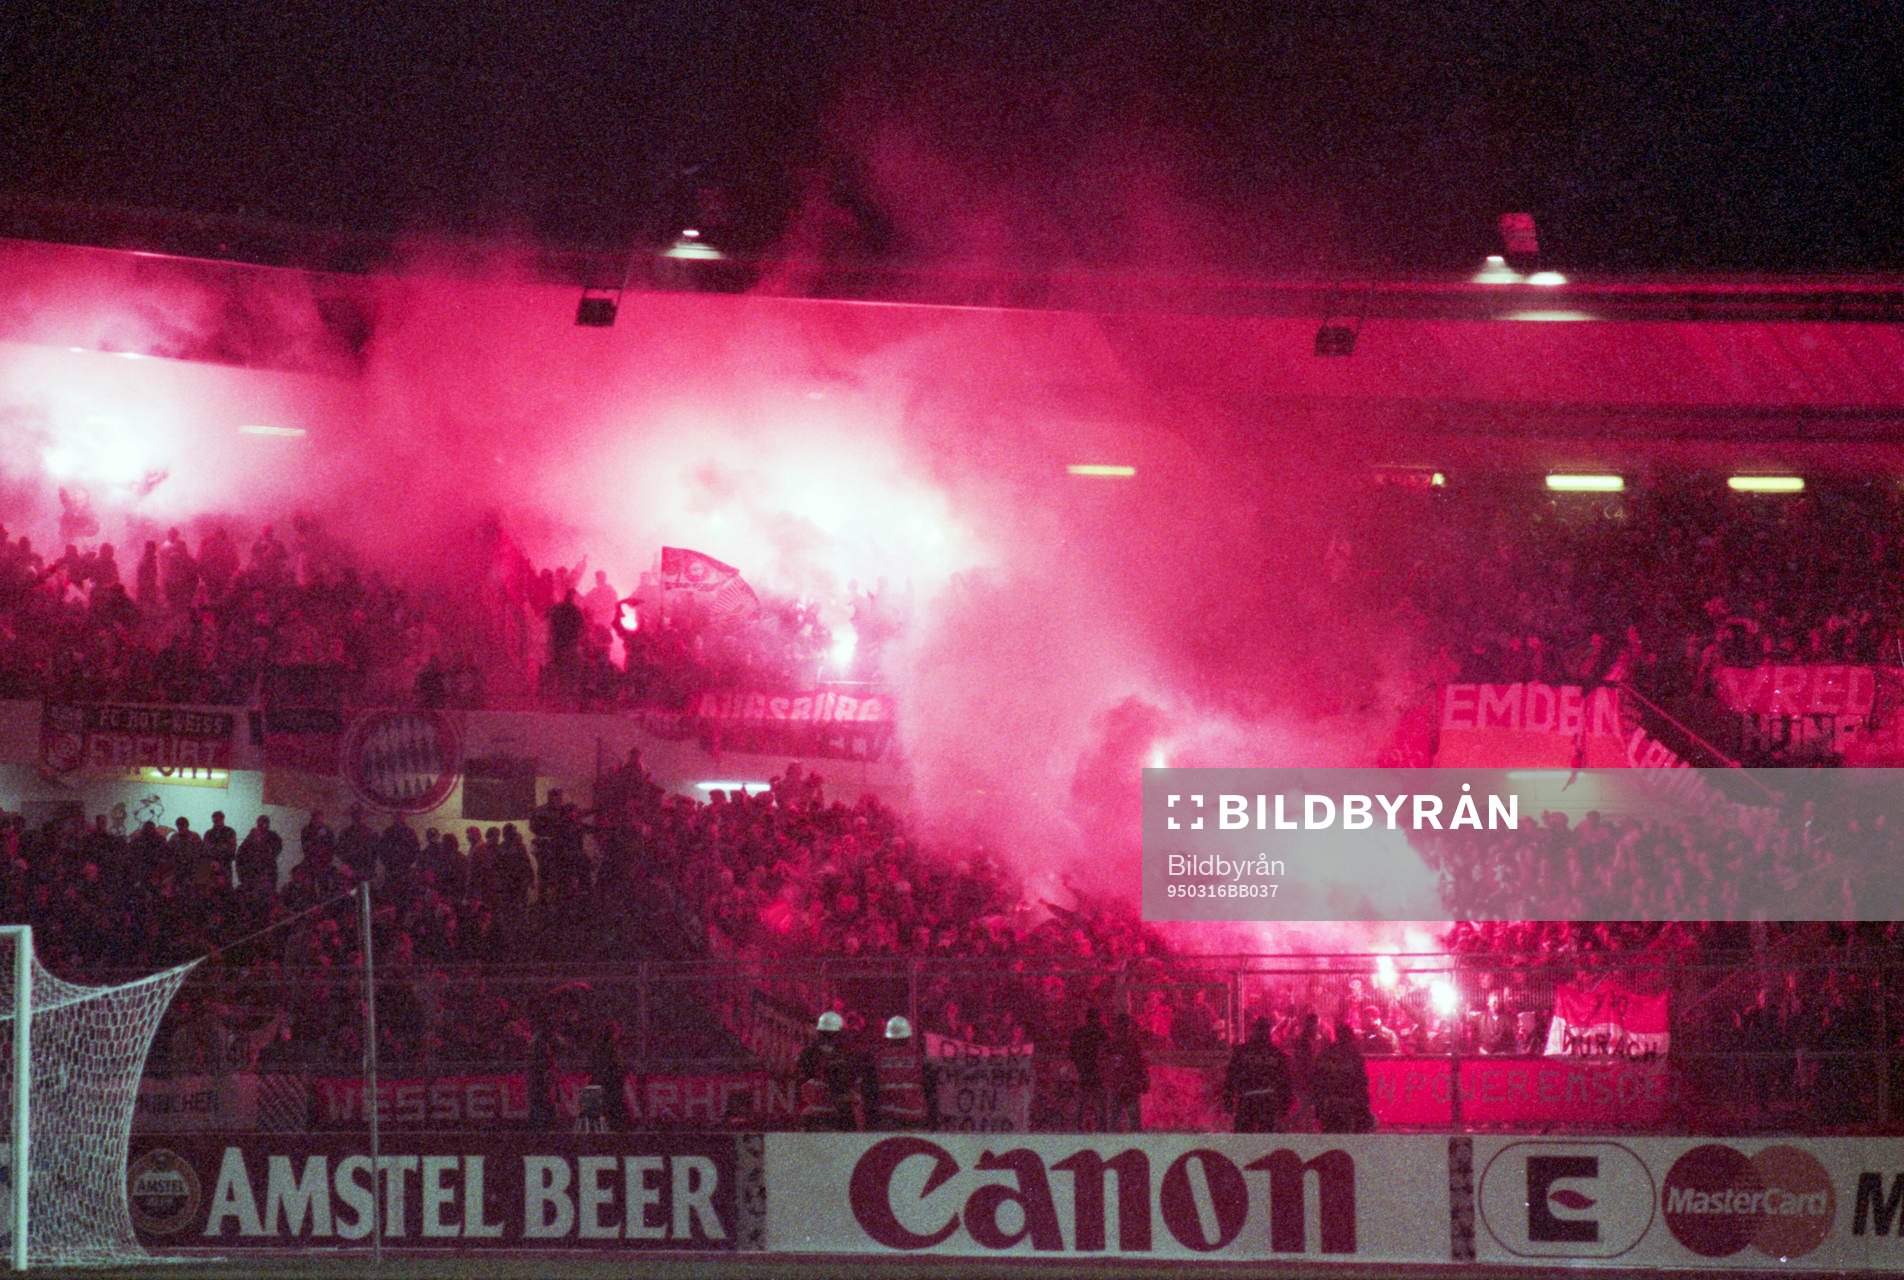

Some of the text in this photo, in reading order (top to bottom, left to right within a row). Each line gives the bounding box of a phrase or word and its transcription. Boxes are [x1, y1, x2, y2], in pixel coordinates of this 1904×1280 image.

[203, 1147, 727, 1241] AMSTEL BEER
[849, 1135, 1357, 1252] Canon
[1666, 1185, 1829, 1217] MasterCard
